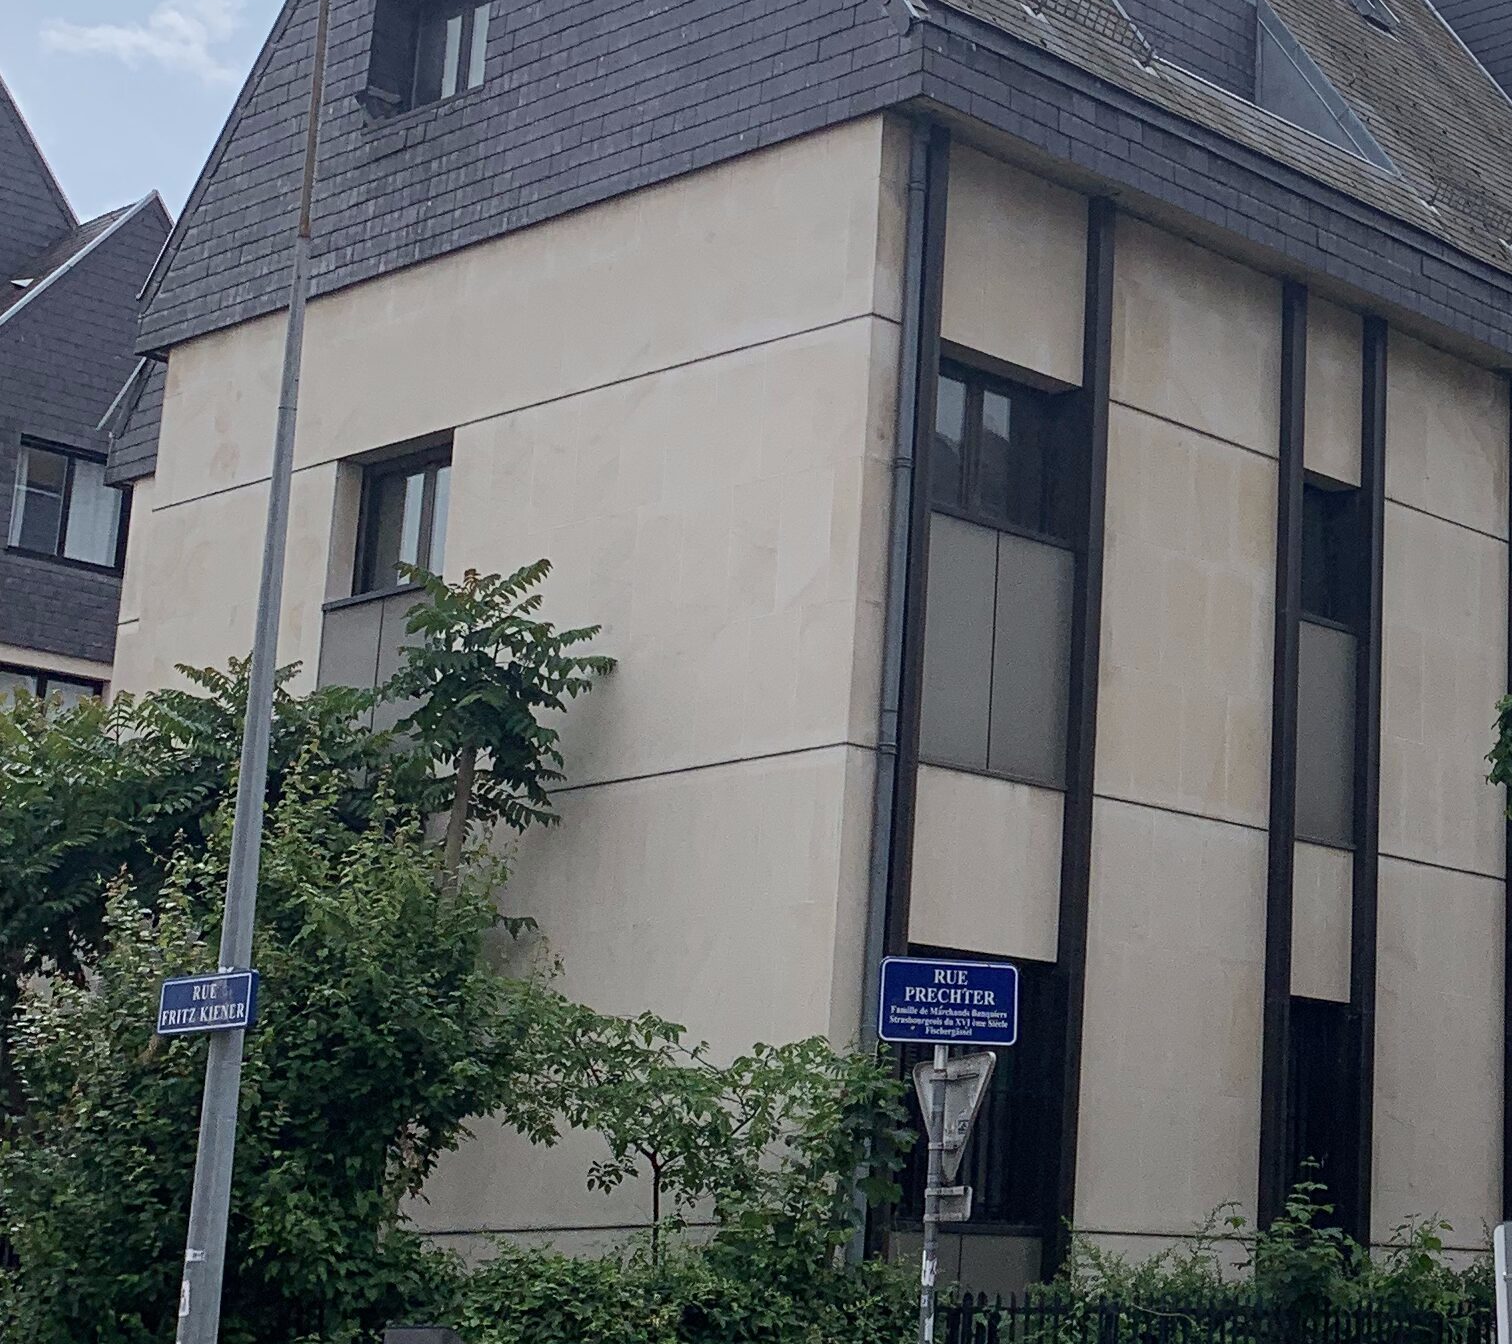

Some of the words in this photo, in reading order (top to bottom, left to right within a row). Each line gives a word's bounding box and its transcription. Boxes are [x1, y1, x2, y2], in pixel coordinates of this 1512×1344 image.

[934, 969, 968, 986] RUE
[193, 984, 217, 1001] RUE
[904, 987, 995, 1006] PRECHTER
[161, 1008, 196, 1026] FRITZ
[199, 1003, 245, 1022] KIENER
[890, 1005, 918, 1015] Famille
[919, 1007, 928, 1015] de
[889, 1016, 943, 1027] Strasbourgeois
[944, 1018, 954, 1026] du
